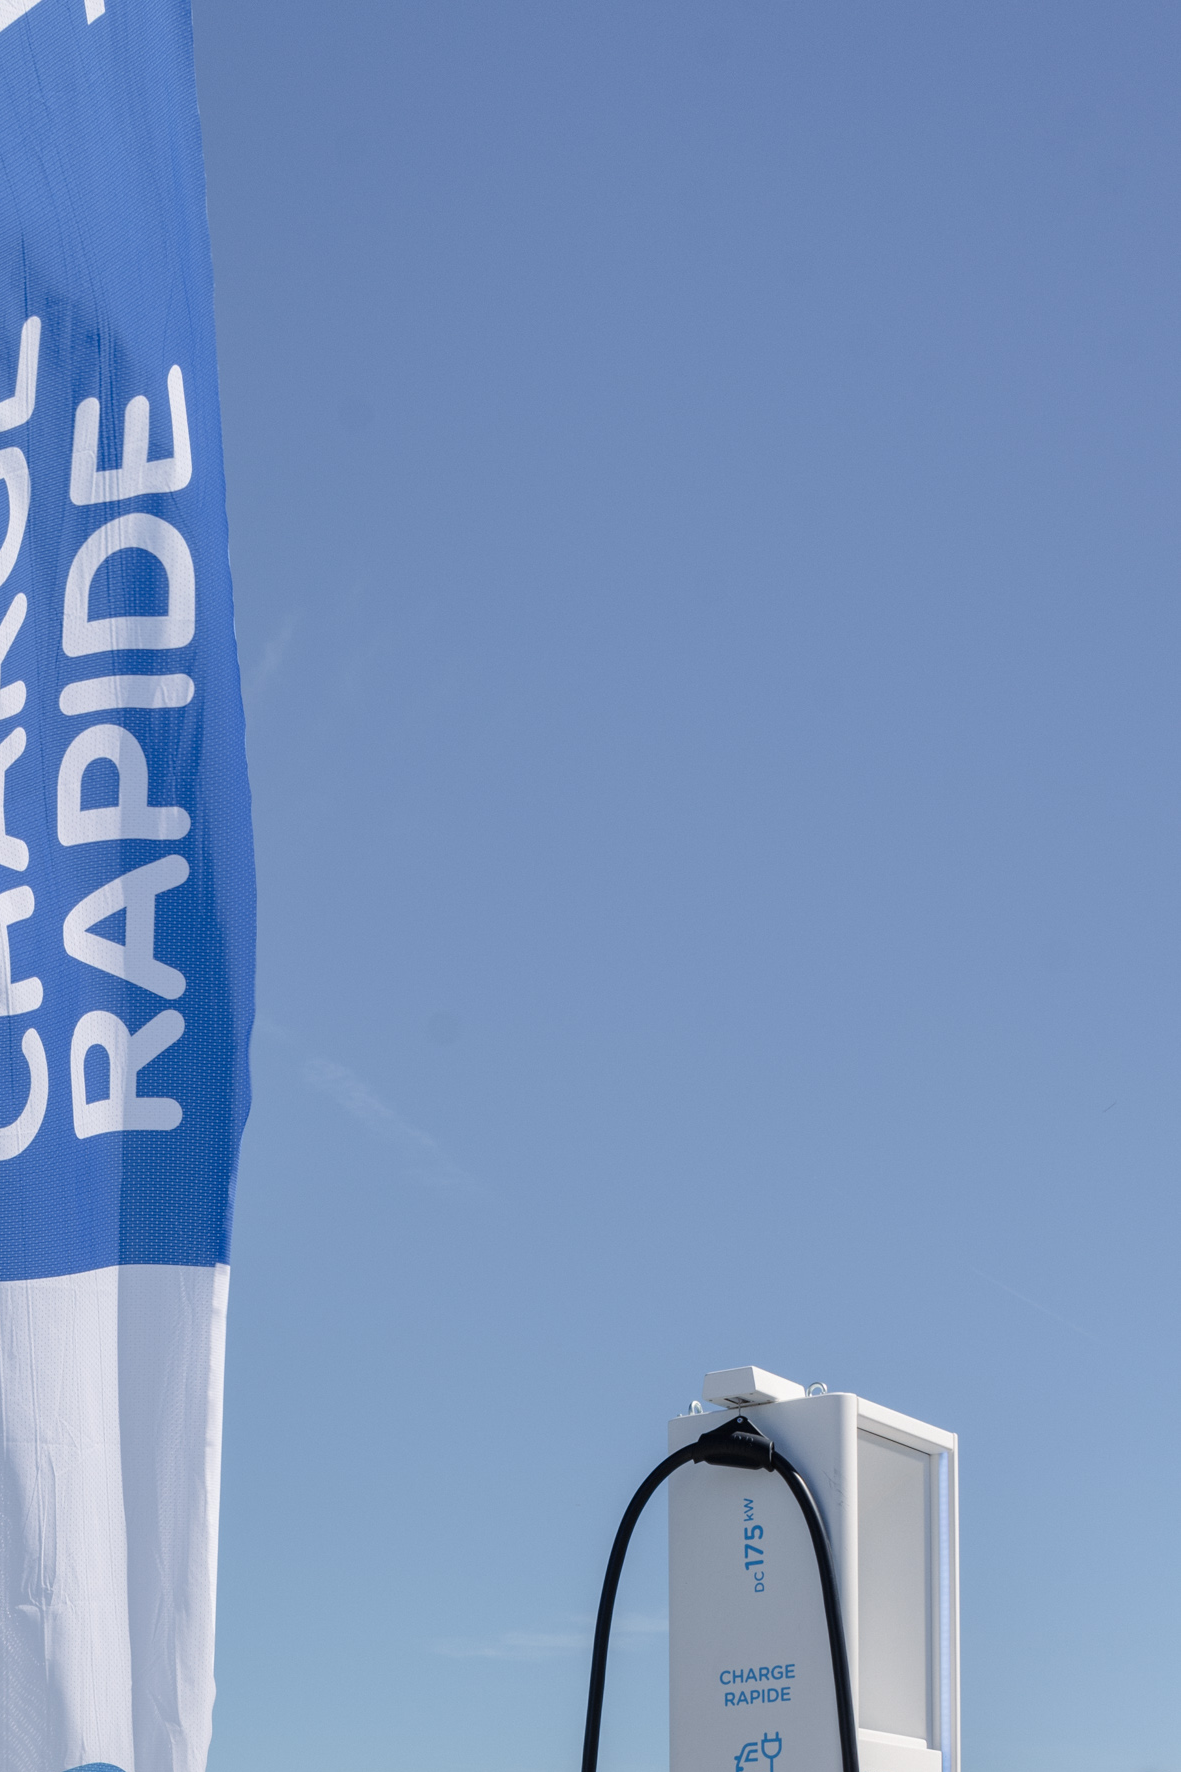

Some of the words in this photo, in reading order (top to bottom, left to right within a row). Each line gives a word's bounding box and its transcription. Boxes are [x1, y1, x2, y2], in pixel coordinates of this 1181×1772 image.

[57, 365, 195, 1139] RAPIDE
[743, 1497, 755, 1523] kW
[744, 1524, 764, 1571] 175
[753, 1571, 765, 1593] DC
[719, 1663, 796, 1685] CHARGE
[724, 1686, 792, 1707] RAPIDE
